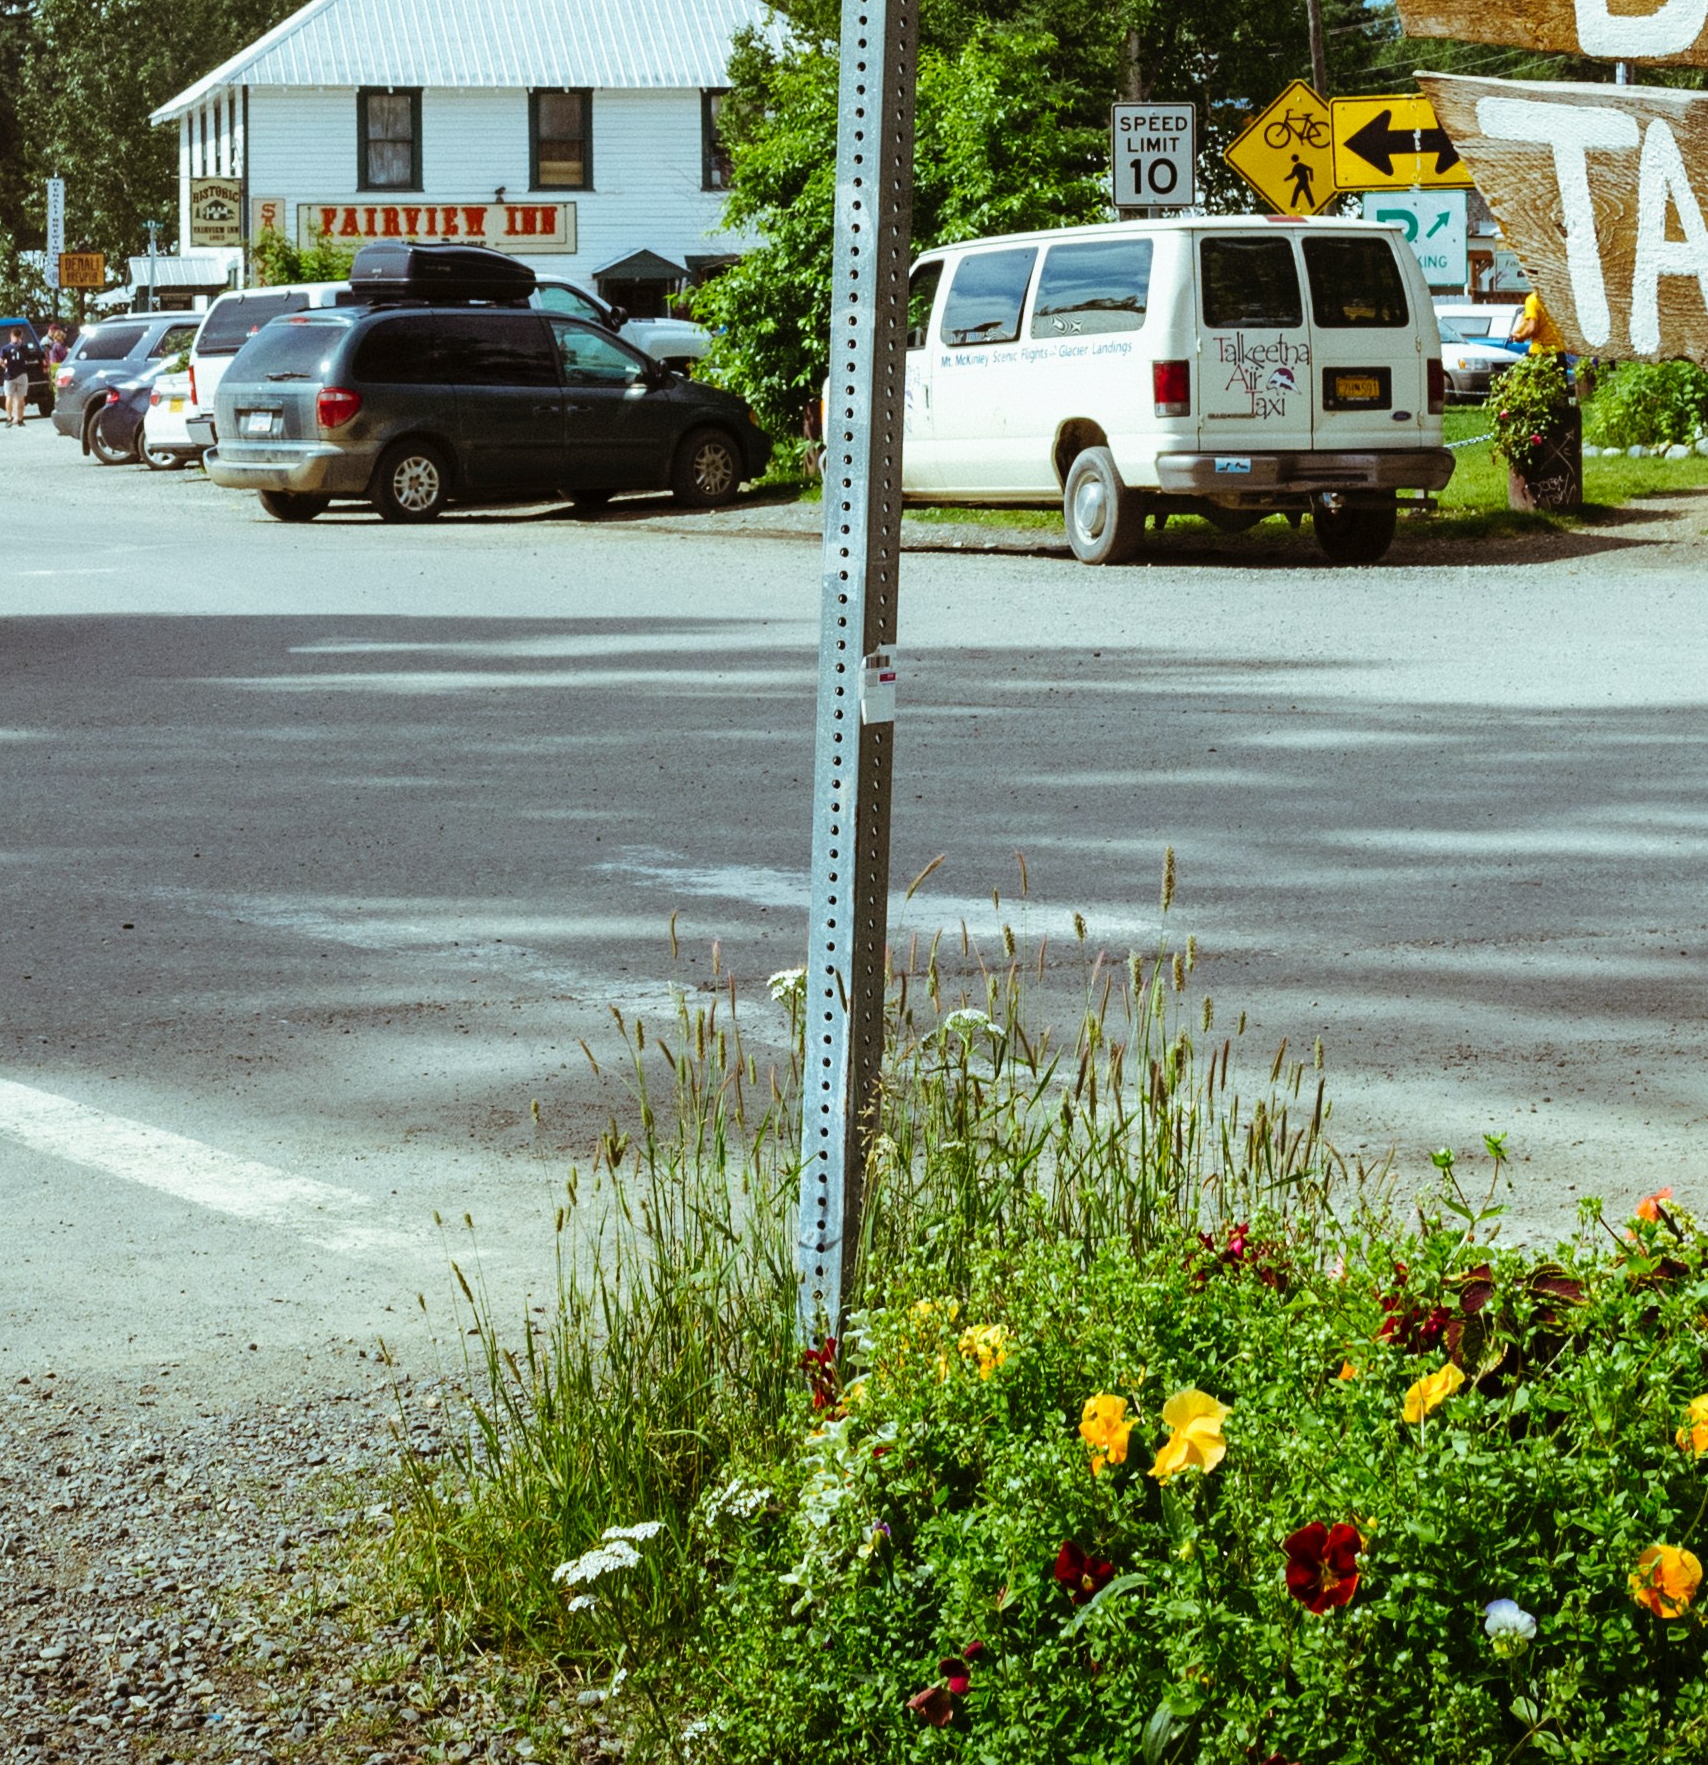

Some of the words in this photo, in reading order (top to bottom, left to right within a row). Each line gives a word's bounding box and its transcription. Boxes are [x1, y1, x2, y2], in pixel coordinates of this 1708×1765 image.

[1120, 116, 1188, 132] SPEED
[1127, 137, 1180, 153] LIMIT
[1130, 158, 1178, 195] 10
[192, 185, 239, 204] HISTORIC
[193, 226, 225, 234] FAIRVIEW
[227, 226, 239, 234] INN
[320, 207, 488, 237] FAIRVIEW
[503, 205, 558, 236] INN
[64, 257, 99, 271] DENALI
[1416, 255, 1448, 269] KING
[955, 351, 989, 367] McKinley
[993, 350, 1017, 363] Scenic
[1021, 347, 1048, 363] Flights
[1059, 344, 1089, 358] Glacier
[1092, 340, 1133, 355] Landings
[1213, 331, 1312, 369] Talkeetna
[1245, 390, 1286, 420] Taxi
